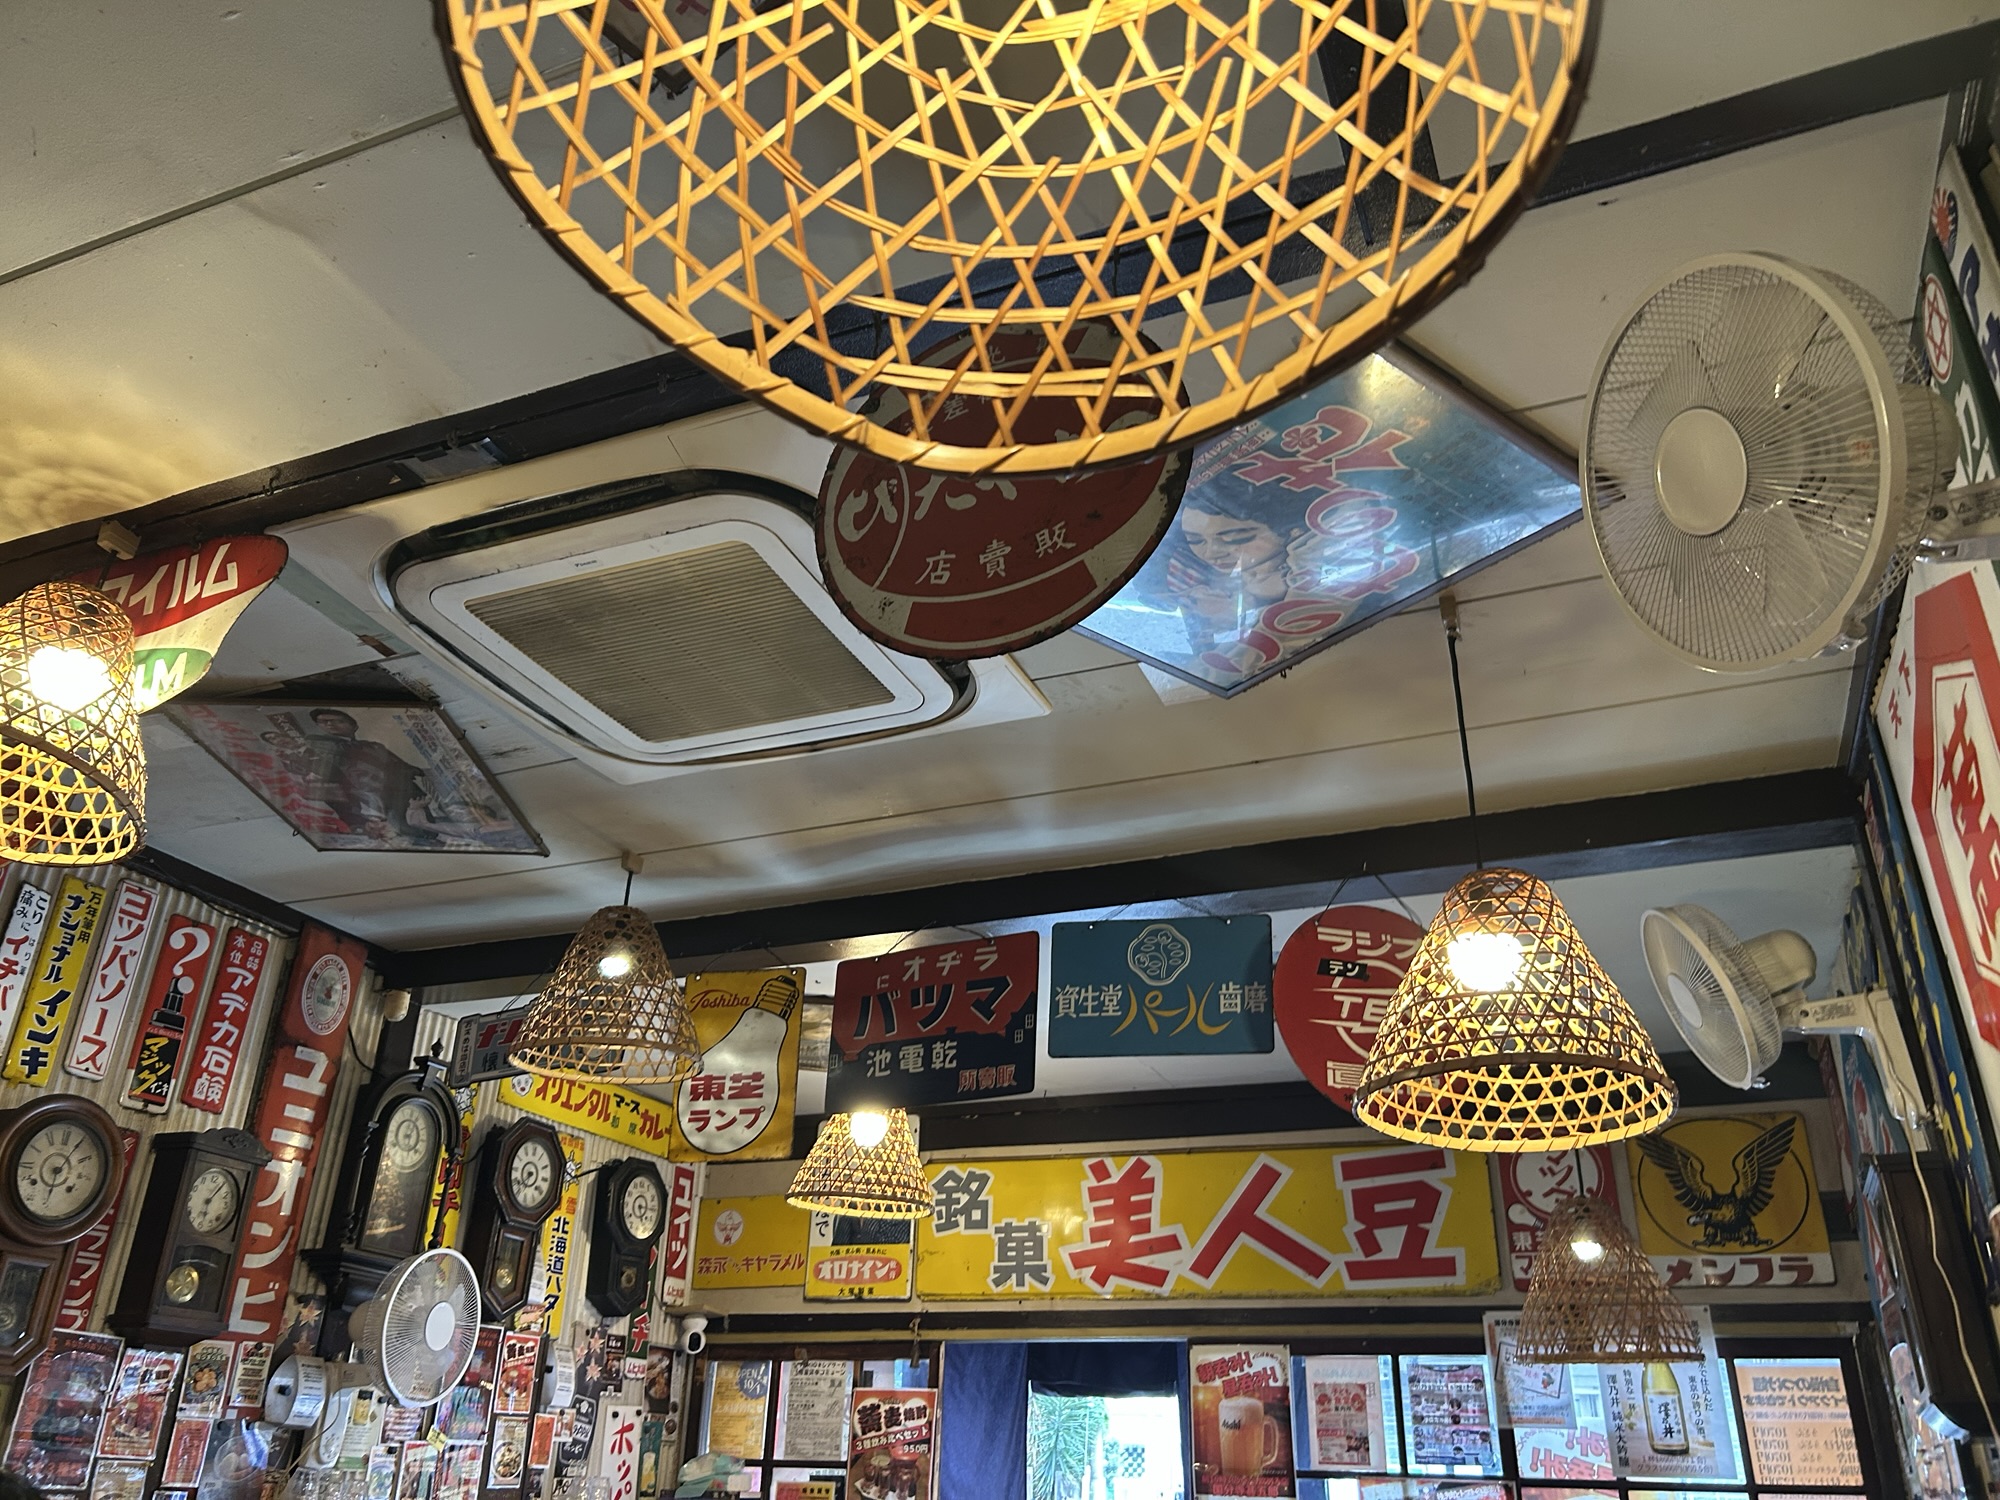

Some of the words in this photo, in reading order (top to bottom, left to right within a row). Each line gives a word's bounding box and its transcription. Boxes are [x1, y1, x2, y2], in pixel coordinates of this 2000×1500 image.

[16, 889, 34, 932] 痛みに
[77, 891, 102, 945] 万年筆用
[229, 935, 246, 965] 本位
[1328, 959, 1360, 977] テン
[0, 935, 29, 1027] イチバ
[689, 988, 751, 1013] Toshiba
[1054, 984, 1122, 1020] 資生堂
[1110, 982, 1233, 1037] パール
[1332, 995, 1388, 1021] TE
[535, 1075, 611, 1122] オリエンタル
[612, 1092, 641, 1116] マース
[689, 1072, 765, 1101] 東芝
[687, 1105, 766, 1133] ランプ
[228, 1046, 329, 1335] ユニオンビ
[932, 1168, 1052, 1289] 銘菓
[1068, 1149, 1458, 1289] 美人豆
[818, 1260, 889, 1280] オロナイン
